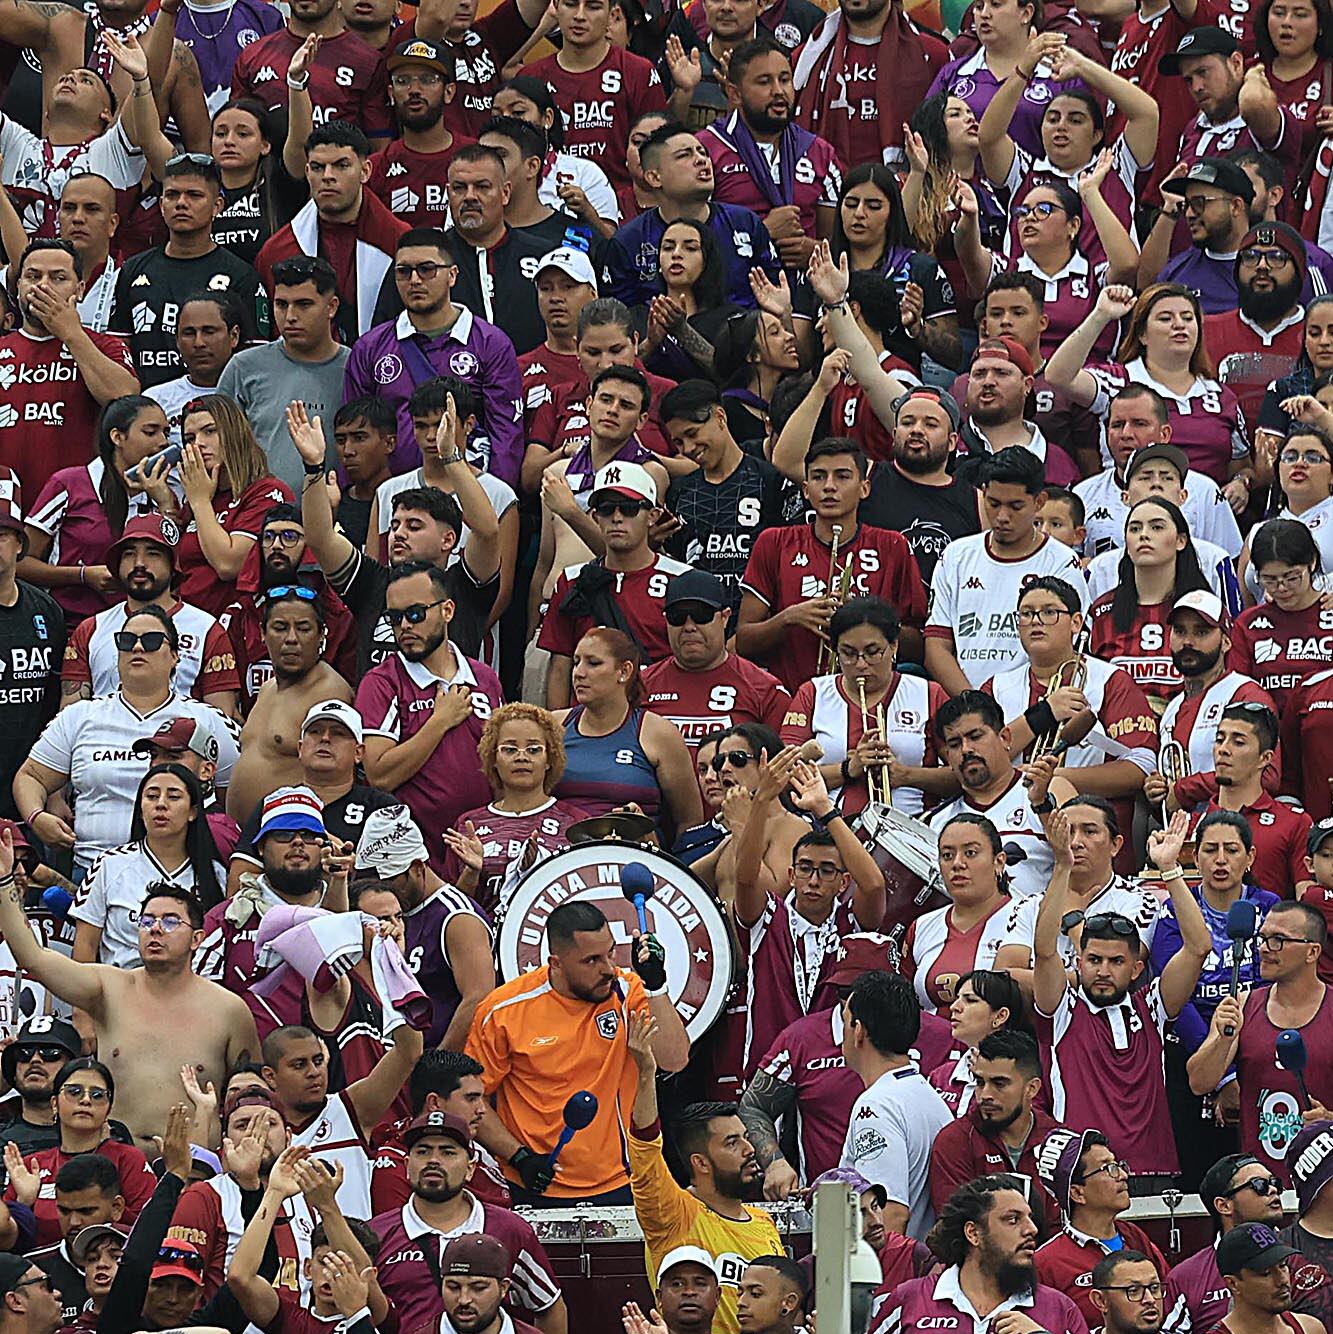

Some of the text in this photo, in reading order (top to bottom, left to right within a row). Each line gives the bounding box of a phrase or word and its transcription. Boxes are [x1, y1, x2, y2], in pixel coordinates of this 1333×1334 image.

[337, 68, 352, 85] S
[602, 71, 621, 92] S
[312, 107, 335, 123] AC
[575, 101, 614, 123] BAC
[574, 120, 613, 129] CREDOMATIC
[795, 159, 816, 183] S
[427, 186, 450, 203] BA
[522, 257, 539, 277] S
[19, 359, 76, 382] kölbi
[1038, 391, 1053, 412] S
[24, 402, 65, 422] BAC
[738, 499, 759, 526] S
[706, 534, 750, 553] BAC
[860, 550, 879, 571] S
[648, 576, 667, 598] S
[36, 615, 47, 639] S
[991, 612, 1019, 631] BA
[1141, 625, 1163, 650] S
[1288, 636, 1333, 656] BAC
[962, 648, 1018, 662] LIBERTY
[473, 693, 491, 719] S
[710, 686, 736, 712] S
[616, 750, 632, 763] S
[346, 803, 364, 823] S
[542, 820, 559, 835] S
[519, 872, 586, 945] ULTRA
[408, 946, 423, 974] S
[428, 1111, 443, 1125] S
[1259, 1124, 1301, 1142] 2019
[1298, 1134, 1333, 1180] PODER
